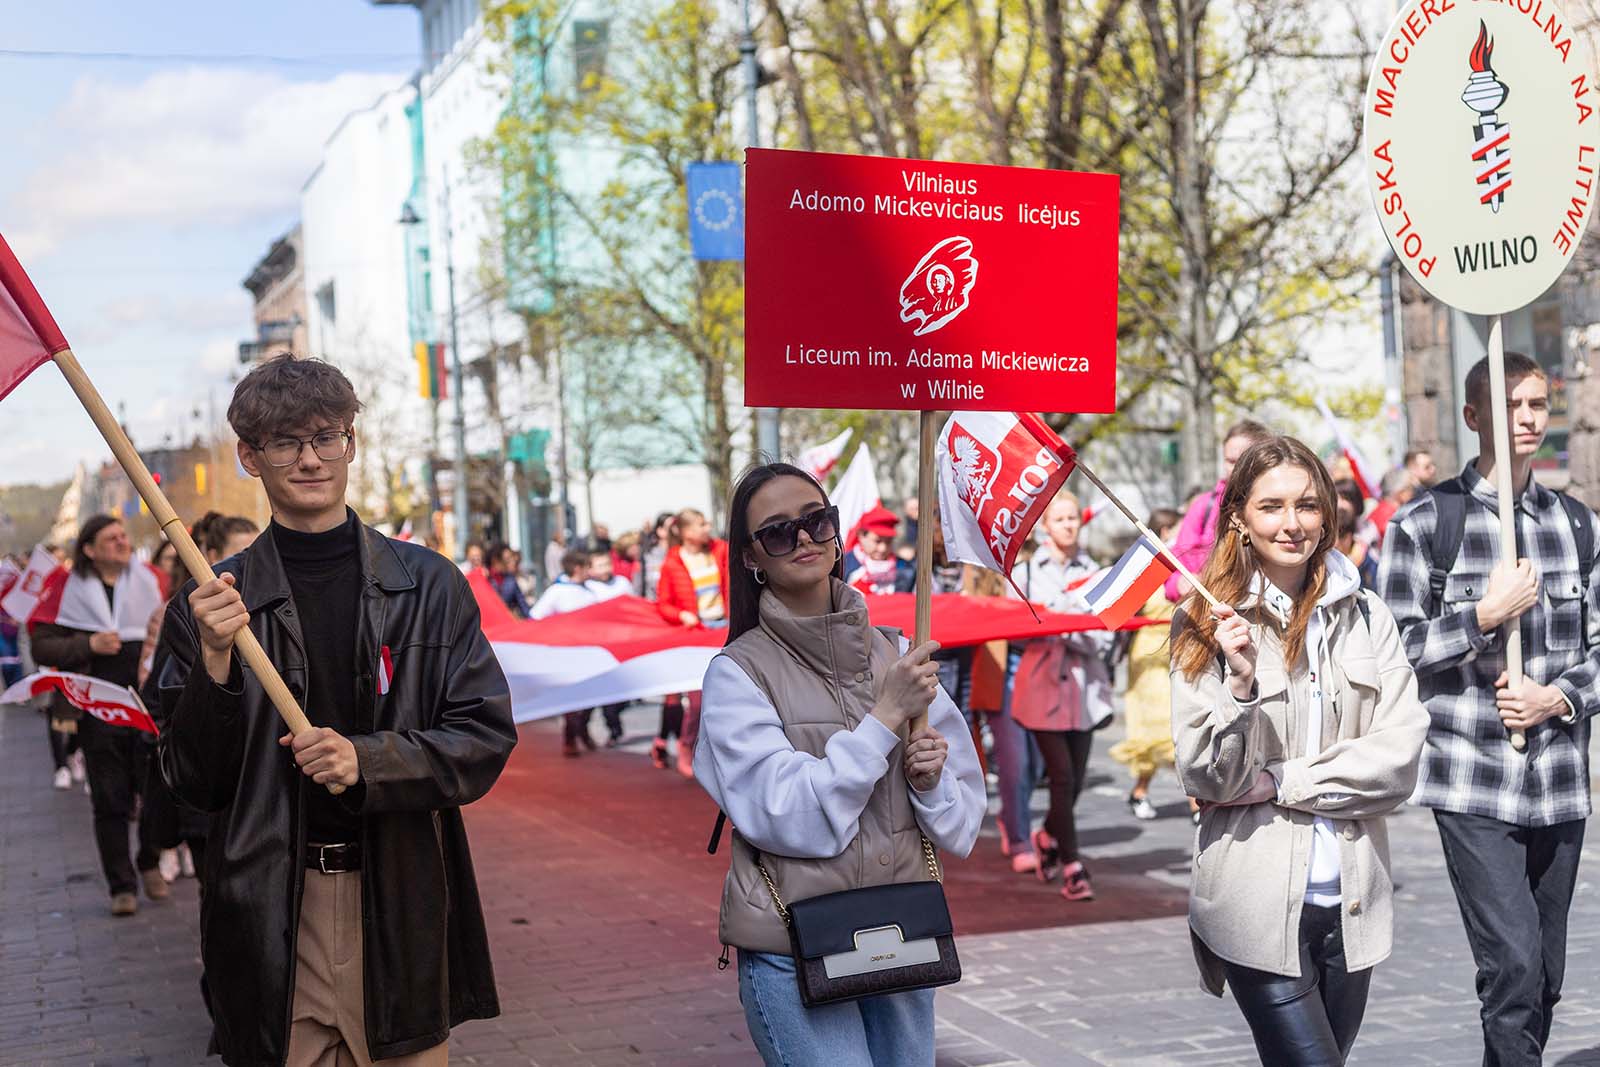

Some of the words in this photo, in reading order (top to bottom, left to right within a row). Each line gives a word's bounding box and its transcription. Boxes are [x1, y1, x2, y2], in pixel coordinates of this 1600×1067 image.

[1472, 0, 1572, 64] OLNA
[1570, 74, 1593, 125] NA
[902, 170, 978, 195] Vilniaus
[1552, 145, 1595, 256] LITWIE
[789, 189, 865, 213] Adomo
[874, 194, 1004, 222] Mickeviciaus
[1373, 139, 1437, 278] POLSKA
[1453, 235, 1538, 274] WILNO
[786, 344, 860, 366] Liceum
[868, 346, 898, 367] im.
[906, 348, 973, 369] Adama
[981, 350, 1089, 373] Mickiewicza
[900, 383, 916, 399] w
[927, 379, 985, 400] Wilnie
